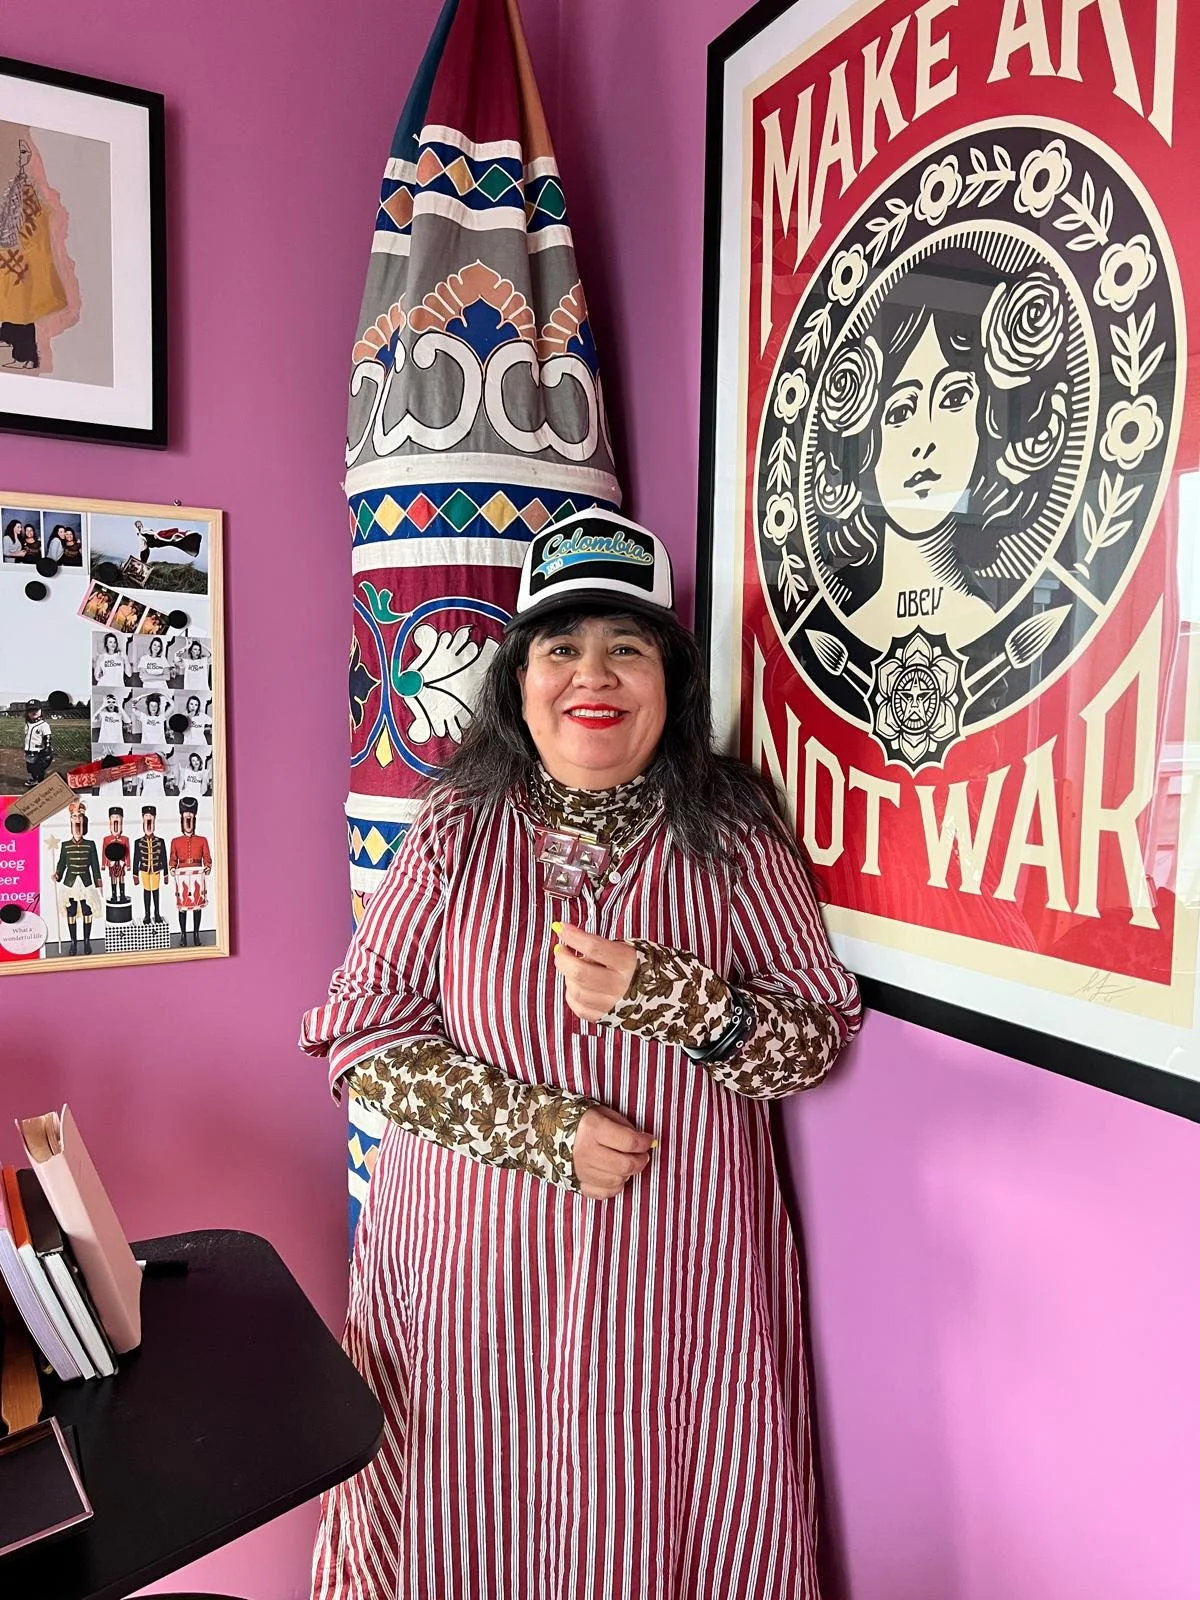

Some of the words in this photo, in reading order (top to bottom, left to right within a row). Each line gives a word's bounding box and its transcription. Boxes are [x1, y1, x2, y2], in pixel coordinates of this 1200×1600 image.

[761, 0, 958, 360] MAKE
[542, 527, 653, 562] Colombia
[897, 587, 943, 618] OBEY
[753, 634, 900, 876] NOT
[914, 593, 1160, 929] WAR
[3, 933, 33, 941] wonderful
